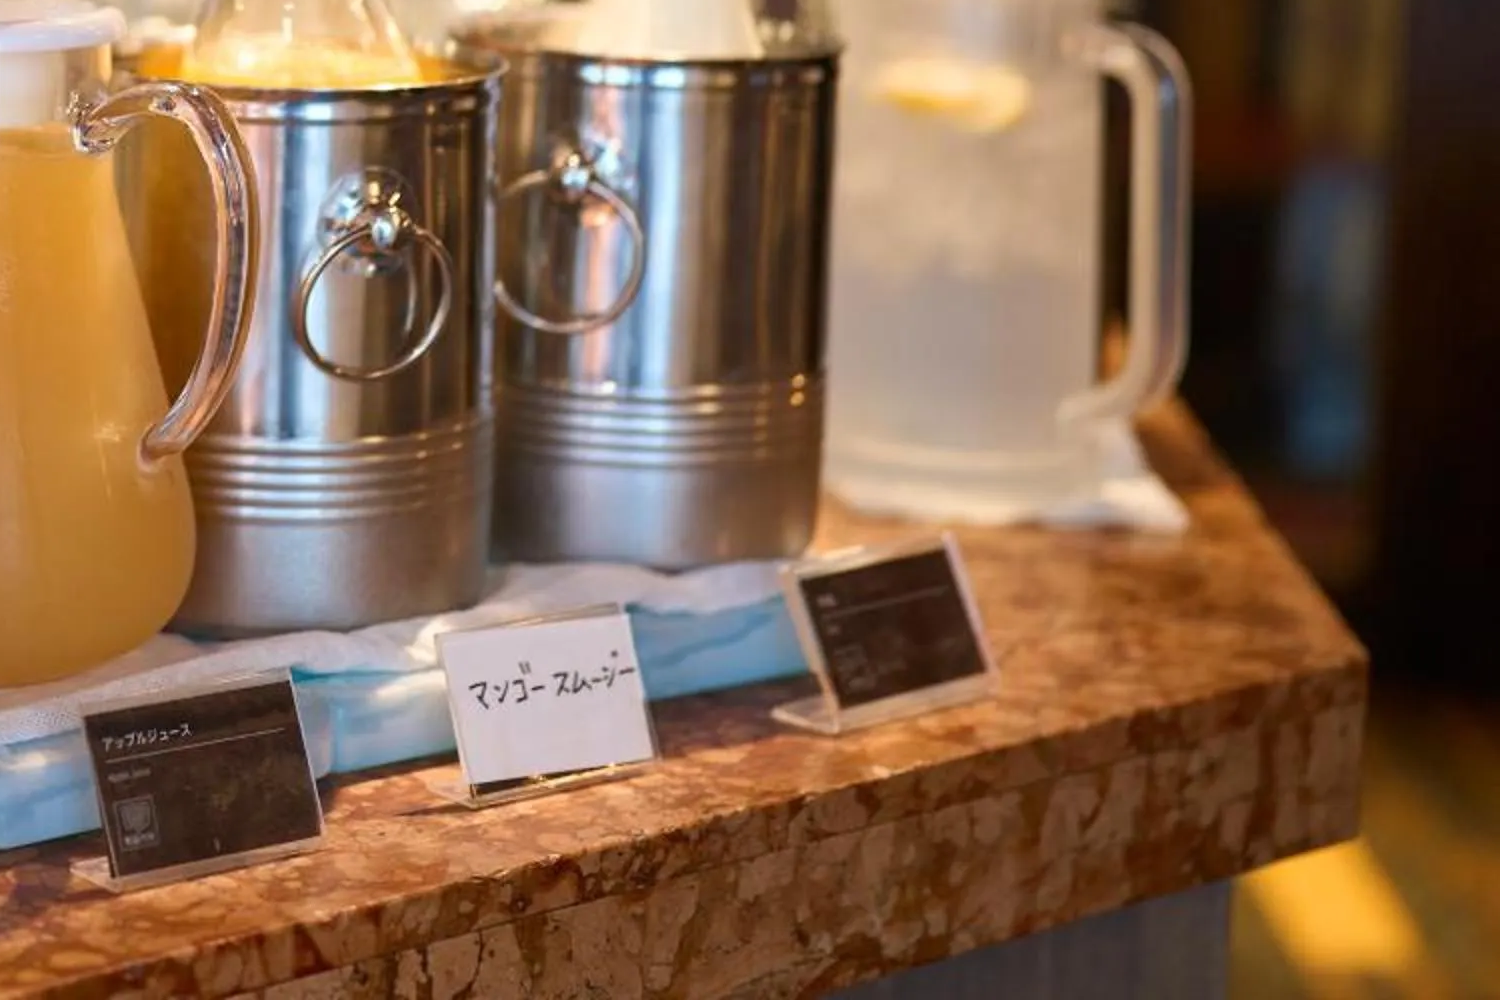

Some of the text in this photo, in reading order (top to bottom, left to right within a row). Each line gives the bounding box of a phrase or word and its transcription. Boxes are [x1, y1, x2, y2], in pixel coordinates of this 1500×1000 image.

[102, 723, 192, 751] アップルジュース
